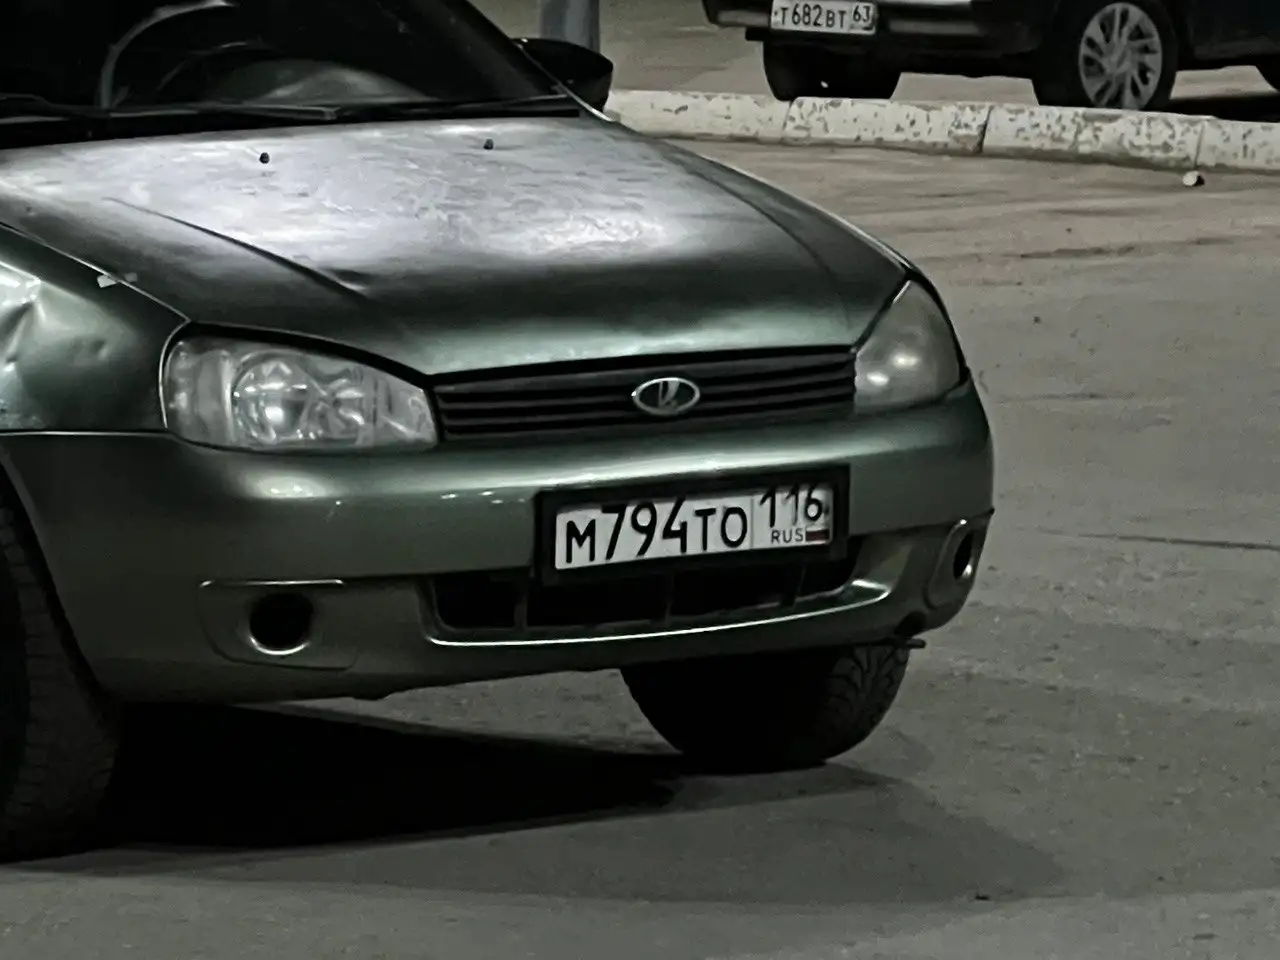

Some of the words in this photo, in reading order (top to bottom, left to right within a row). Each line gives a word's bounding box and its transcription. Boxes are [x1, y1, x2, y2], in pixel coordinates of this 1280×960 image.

[852, 5, 872, 23] 63
[566, 498, 748, 564] М794ТО
[760, 485, 823, 527] 116
[771, 527, 804, 543] RUS
